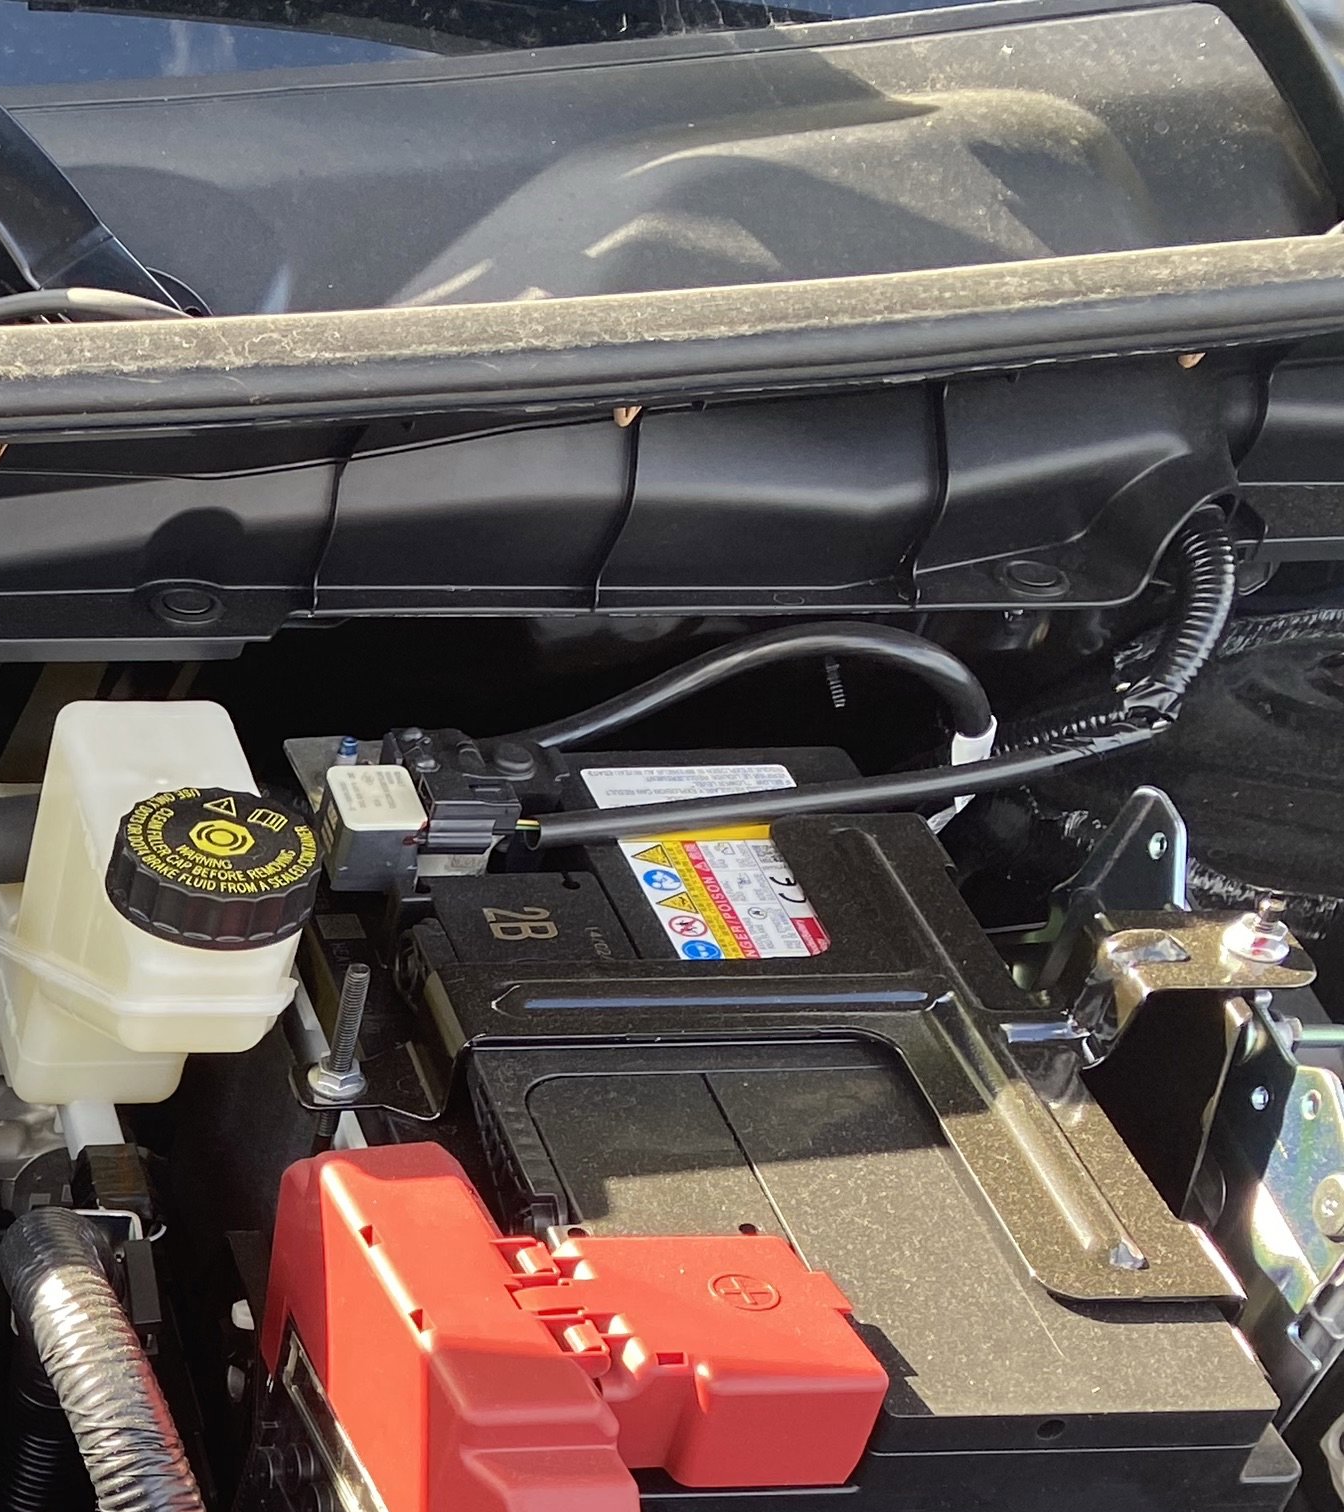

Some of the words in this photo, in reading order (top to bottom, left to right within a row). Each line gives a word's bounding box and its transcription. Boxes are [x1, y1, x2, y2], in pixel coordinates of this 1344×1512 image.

[177, 788, 201, 800] USE
[175, 844, 233, 870] WARNING
[294, 825, 317, 868] CONTAINER
[141, 854, 181, 880] BRAKE
[166, 854, 193, 870] CAP
[191, 865, 247, 882] BEFORE
[246, 848, 297, 881] REMOVING
[267, 864, 308, 889] SEALED
[177, 873, 216, 892] FLUID
[220, 881, 258, 894] FROM
[259, 881, 271, 892] A
[482, 906, 559, 941] 2B
